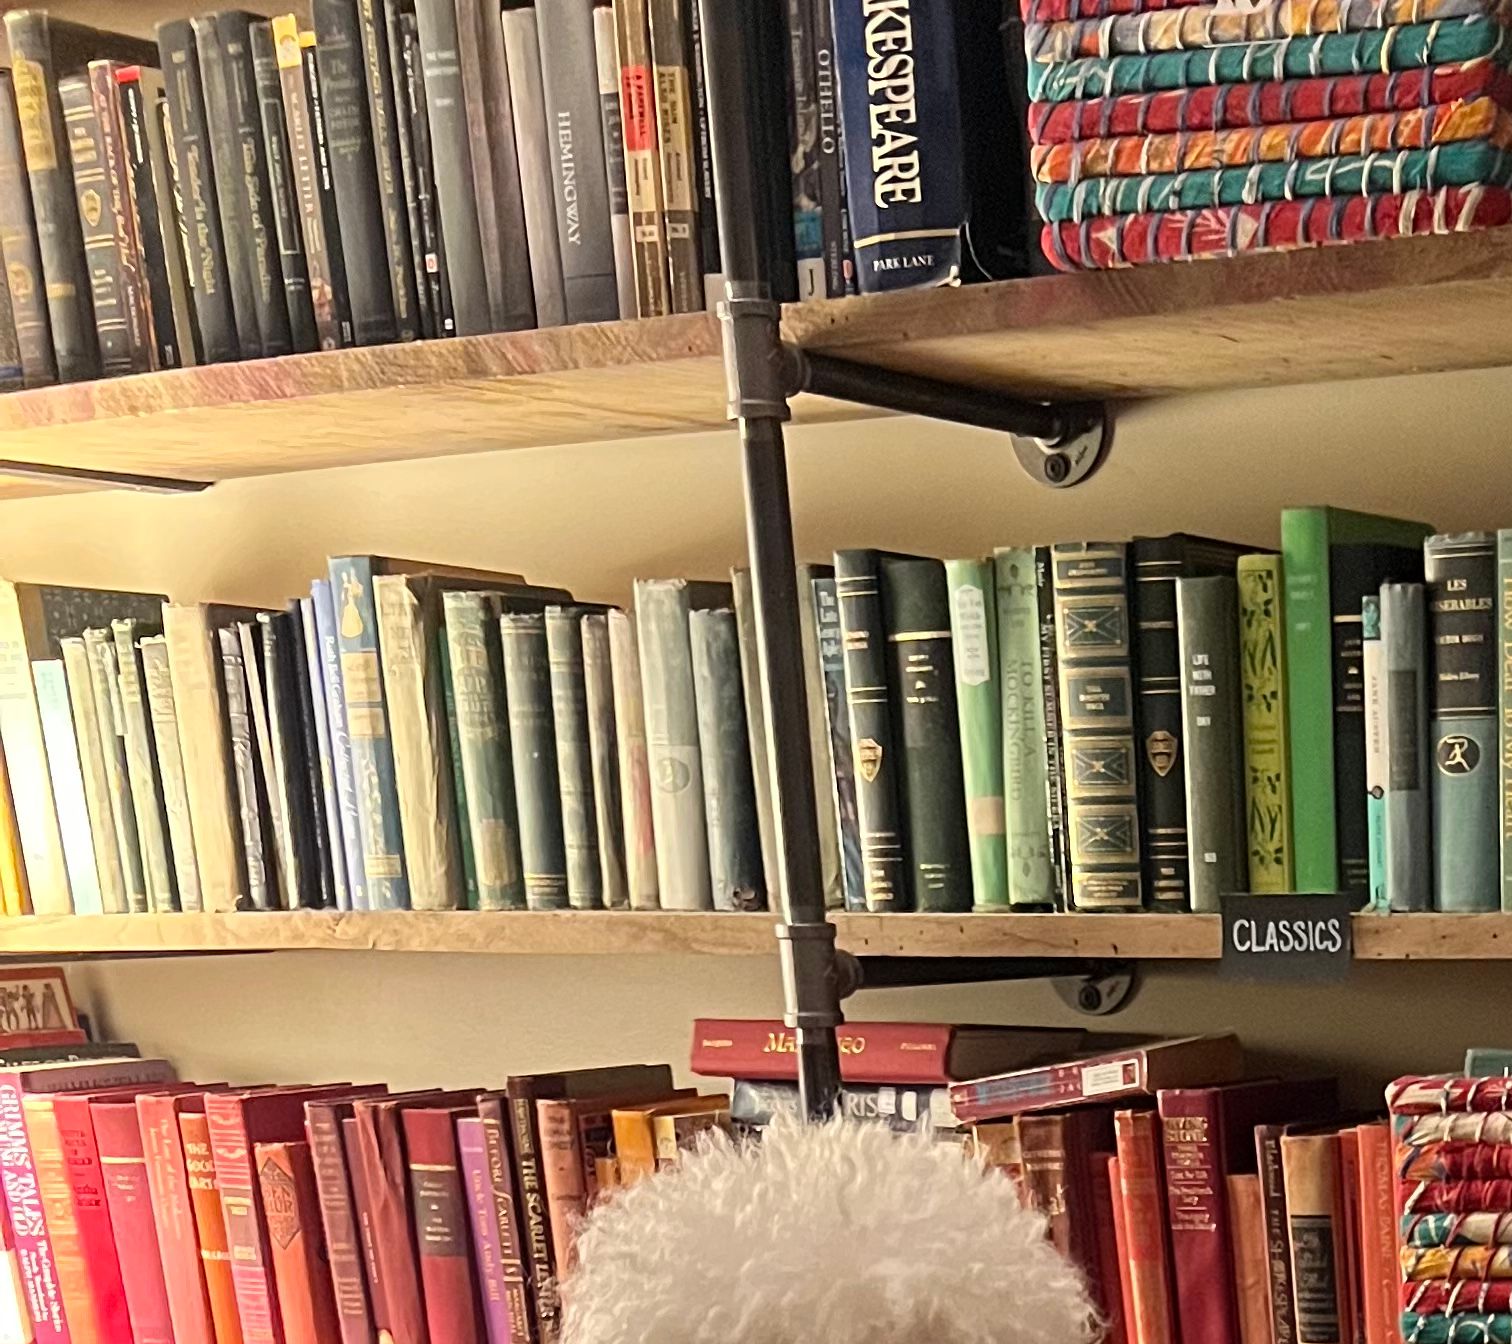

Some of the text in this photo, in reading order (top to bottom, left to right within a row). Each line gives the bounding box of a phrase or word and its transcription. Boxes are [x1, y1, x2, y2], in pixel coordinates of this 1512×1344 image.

[818, 49, 834, 154] OTHELLO
[862, 0, 921, 209] KESPEARE
[557, 111, 580, 245] HEMINGWAY
[873, 252, 936, 272] PARK LANE
[1005, 658, 1021, 801] MOCKINGBIRD
[1022, 659, 1034, 757] TO KILL A
[1372, 711, 1380, 754] AUSTEN
[1233, 919, 1341, 952] CLASSICS
[471, 1169, 486, 1202] Uncle
[479, 1208, 490, 1236] Tom
[487, 1278, 500, 1301] Bill
[522, 1159, 546, 1259] THE SCARLET
